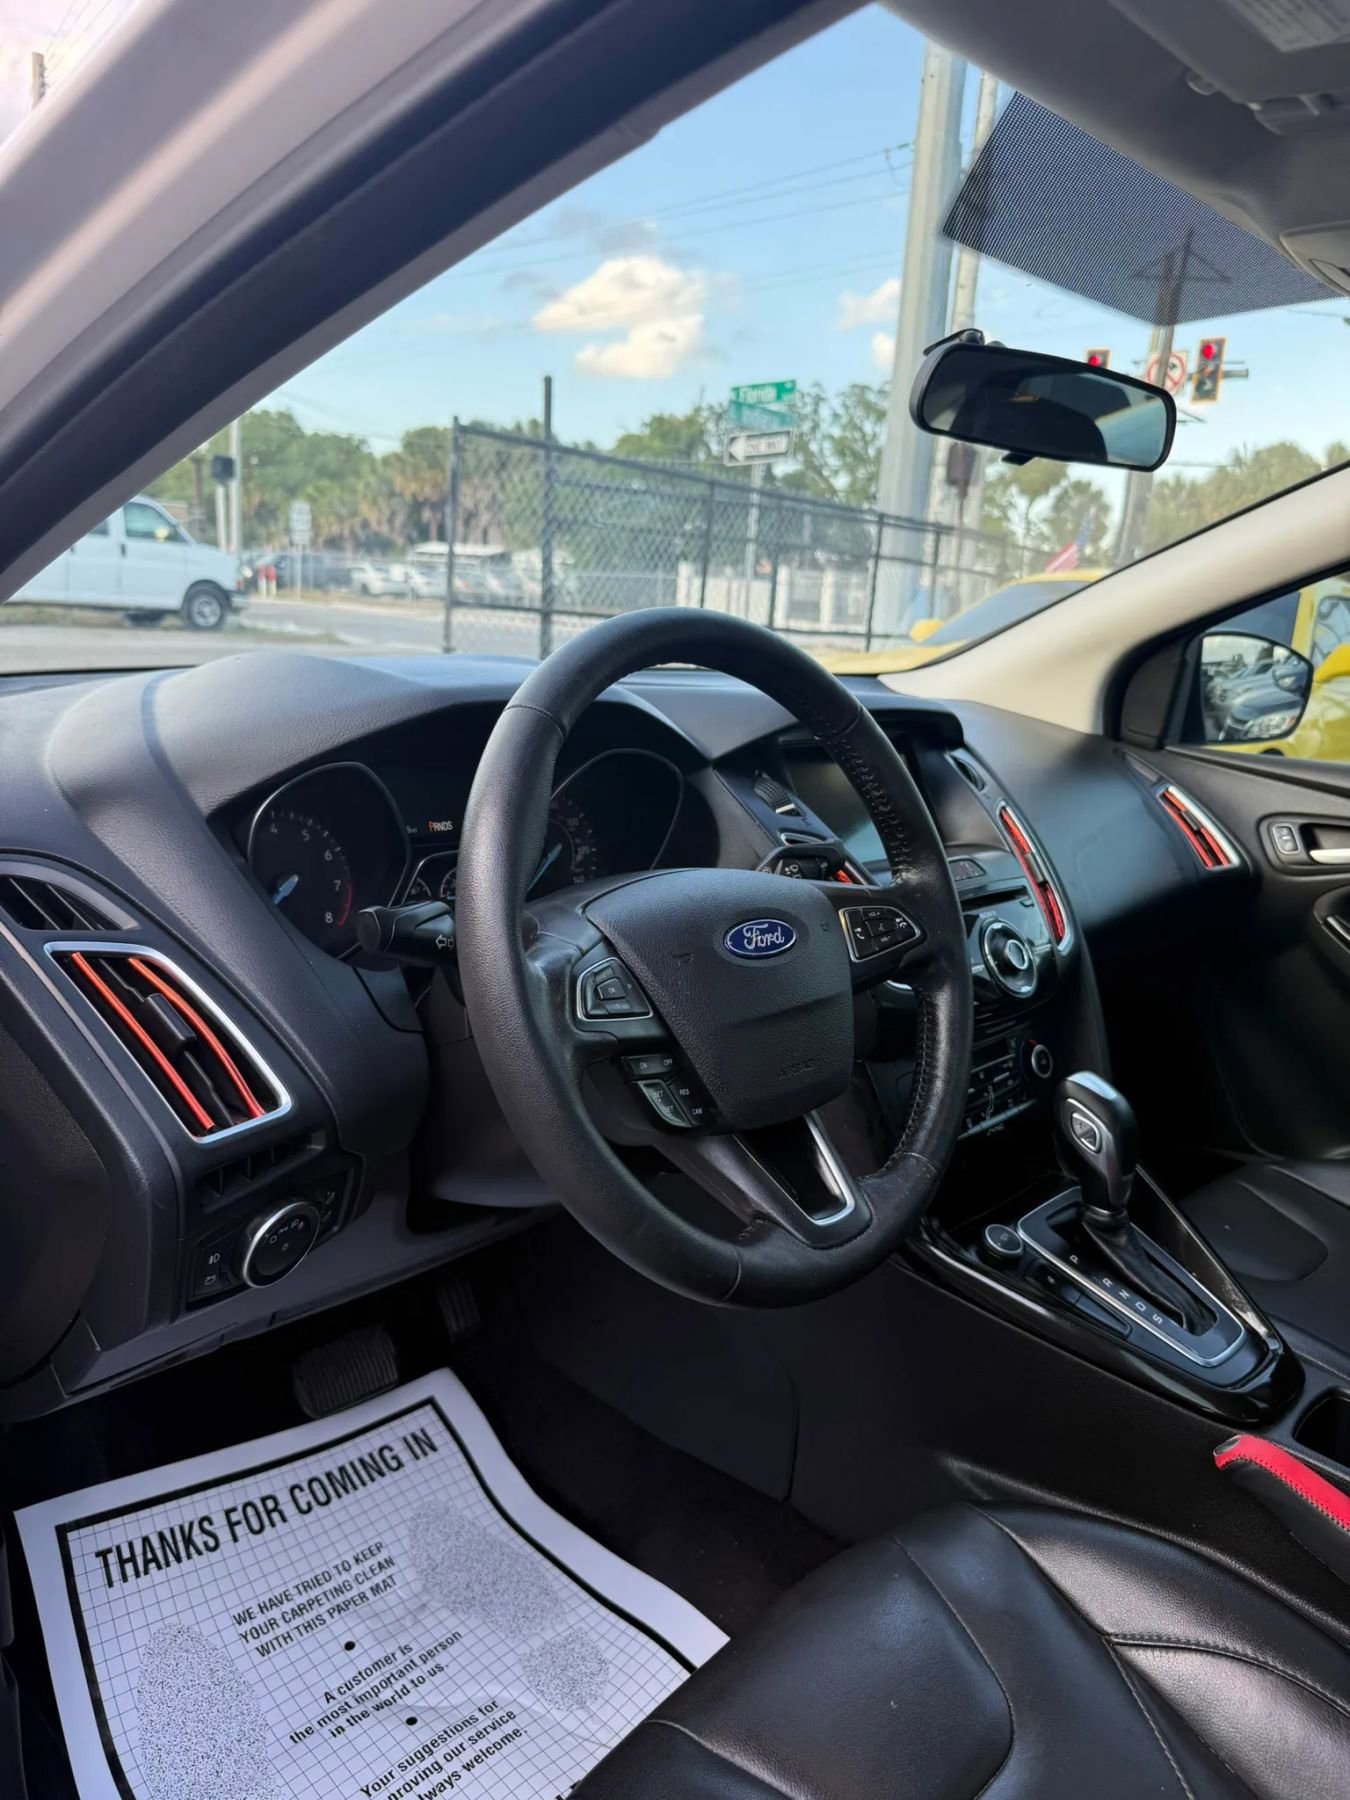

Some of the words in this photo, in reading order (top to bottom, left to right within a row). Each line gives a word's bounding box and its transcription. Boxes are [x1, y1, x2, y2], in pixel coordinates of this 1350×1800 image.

[302, 829, 310, 841] 5
[324, 849, 333, 860] 6
[428, 821, 453, 831] PRNDS
[333, 880, 341, 891] 7
[325, 912, 333, 924] 8
[743, 923, 785, 949] Ford
[1069, 1254, 1079, 1264] P
[1102, 1277, 1113, 1288] R
[1118, 1289, 1130, 1300] N
[1135, 1301, 1147, 1312] D
[1152, 1313, 1163, 1325] S
[95, 1515, 220, 1589] THANKS
[224, 1493, 288, 1543] FOR
[289, 1444, 405, 1515] COMING
[403, 1427, 440, 1461] IN
[232, 1606, 257, 1626] WE
[257, 1588, 294, 1615] HAVE
[294, 1570, 333, 1596] TRIED
[333, 1559, 352, 1576] TO
[352, 1541, 384, 1566] KEEP
[240, 1617, 280, 1644] YOUR
[281, 1579, 354, 1624] CARPETING
[354, 1556, 396, 1585] CLEAN
[255, 1630, 294, 1658] WITH
[293, 1614, 327, 1638] THIS
[327, 1591, 369, 1620] PAPER
[370, 1574, 398, 1597] MAT
[289, 1725, 315, 1745] the
[316, 1700, 354, 1728] most
[354, 1659, 419, 1706] important
[418, 1630, 463, 1665] person
[323, 1691, 336, 1704] A
[337, 1652, 398, 1697] customer
[398, 1643, 414, 1656] is
[329, 1724, 346, 1739] in
[345, 1708, 371, 1728] the
[372, 1684, 411, 1713] world
[410, 1674, 426, 1689] to
[428, 1662, 450, 1678] us.
[360, 1769, 395, 1797] Your
[397, 1714, 479, 1772] suggestions
[478, 1700, 499, 1716] for
[443, 1742, 466, 1762] our
[467, 1711, 517, 1745] service
[461, 1728, 528, 1772] welcome.
